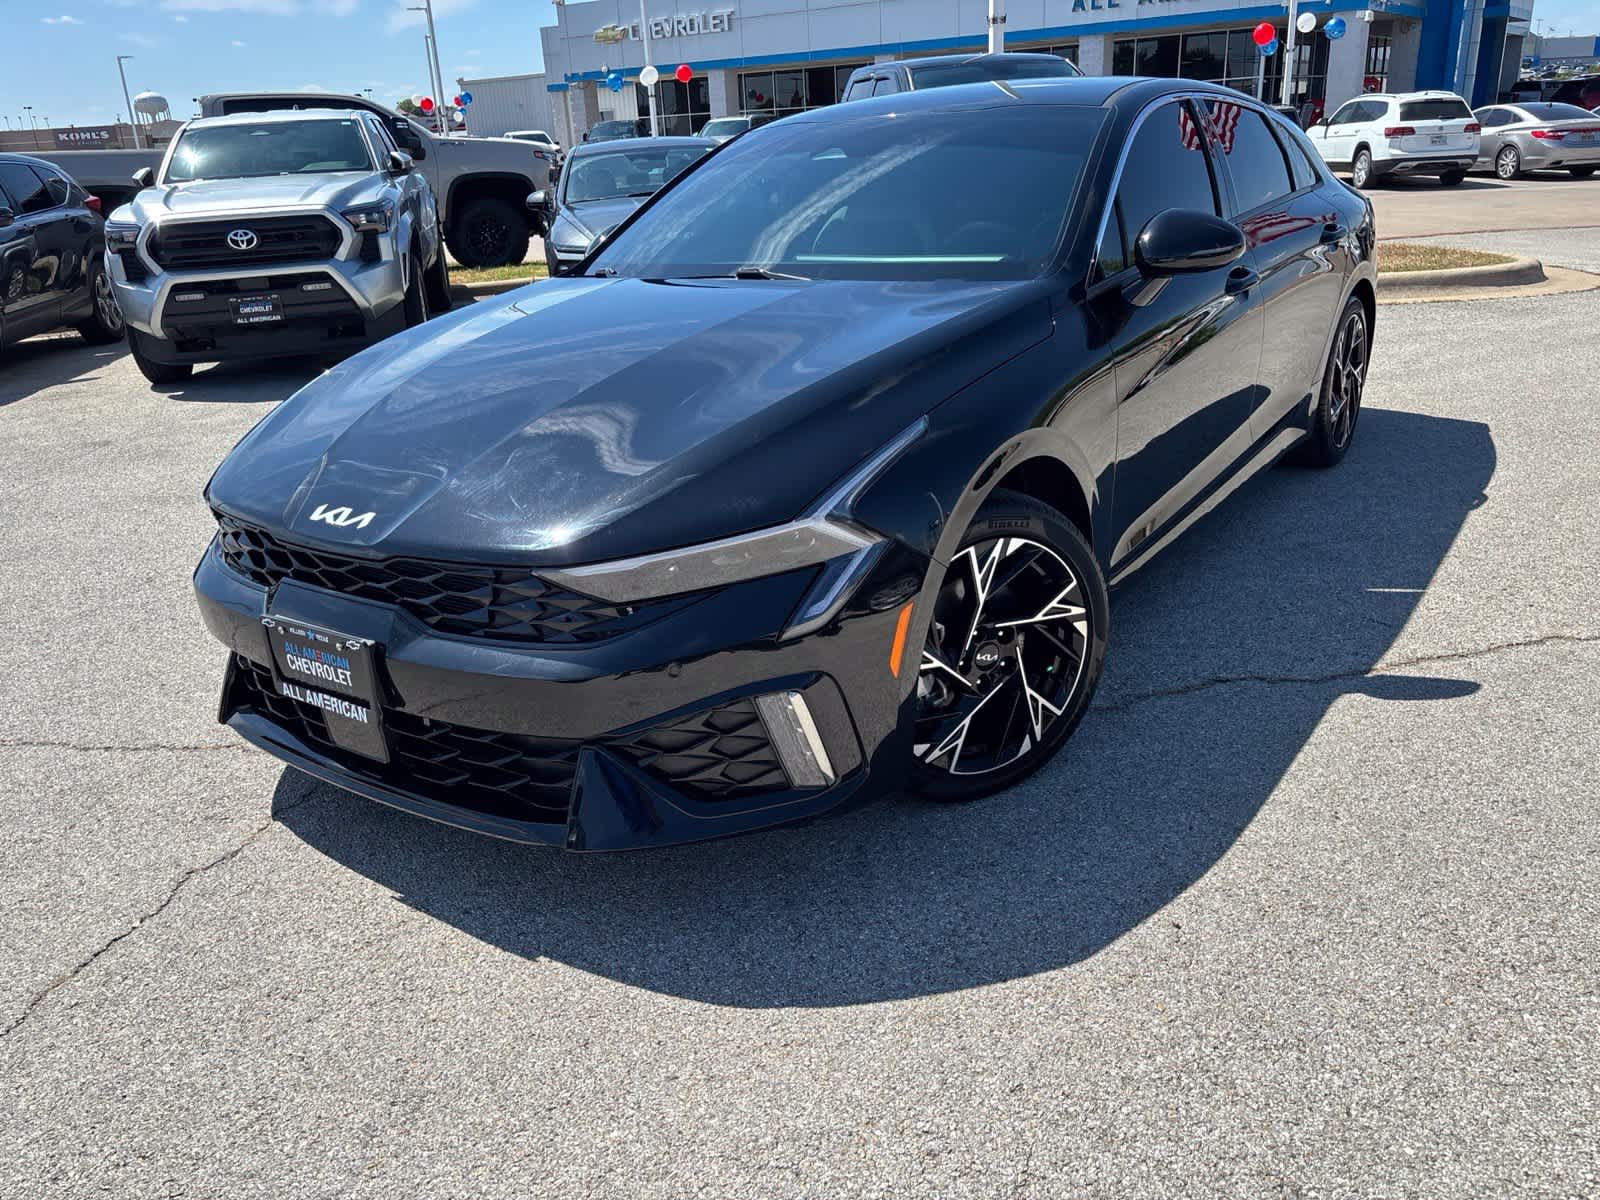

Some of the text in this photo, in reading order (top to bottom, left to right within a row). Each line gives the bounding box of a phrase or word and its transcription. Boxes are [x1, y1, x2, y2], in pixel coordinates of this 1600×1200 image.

[58, 130, 110, 141] KOHL'S
[284, 640, 350, 671] ALL AMERICAN
[286, 653, 352, 687] CHEVROLET
[282, 682, 369, 723] ALL AMERICAN
